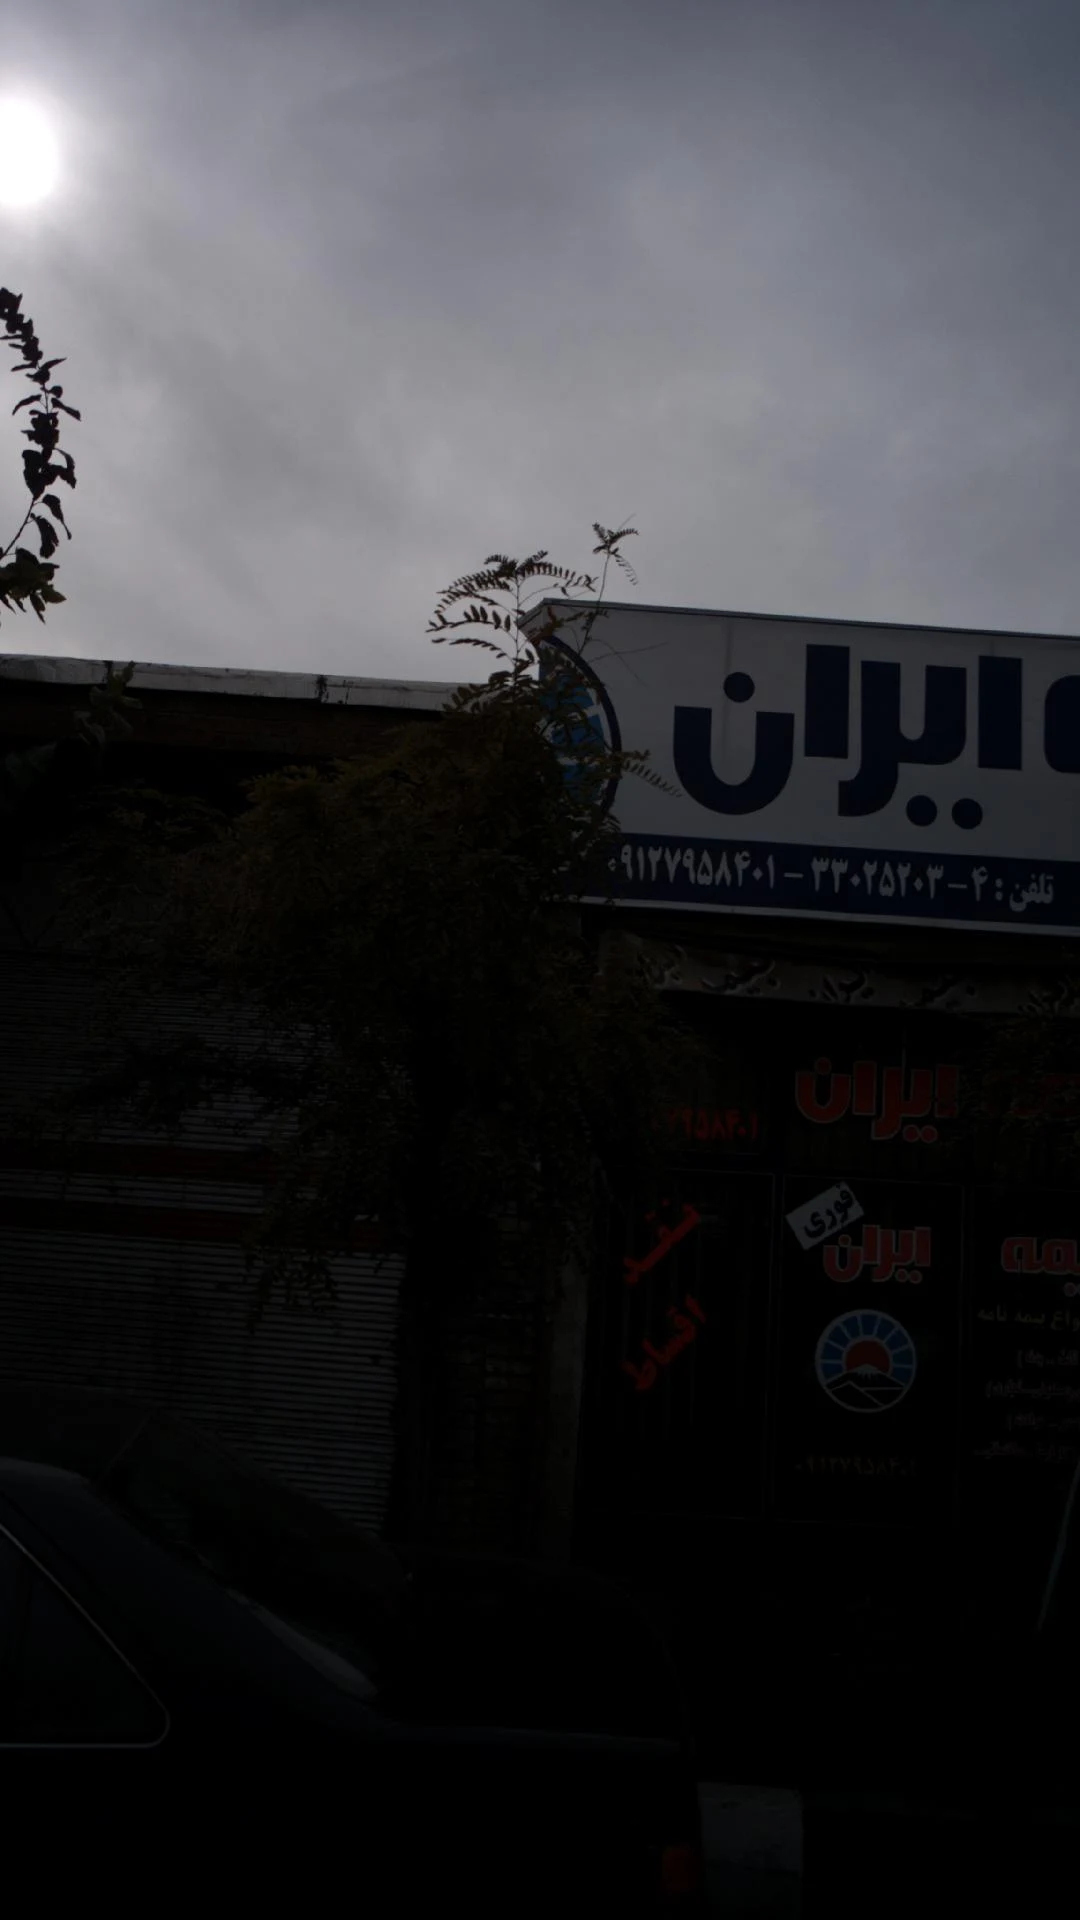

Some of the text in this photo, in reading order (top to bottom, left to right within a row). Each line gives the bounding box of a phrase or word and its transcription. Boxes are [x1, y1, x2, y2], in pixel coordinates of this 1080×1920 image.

[673, 644, 1022, 829] ایران
[794, 1056, 960, 1142] ایران
[804, 1184, 854, 1239] فوری
[822, 1222, 933, 1285] ایران
